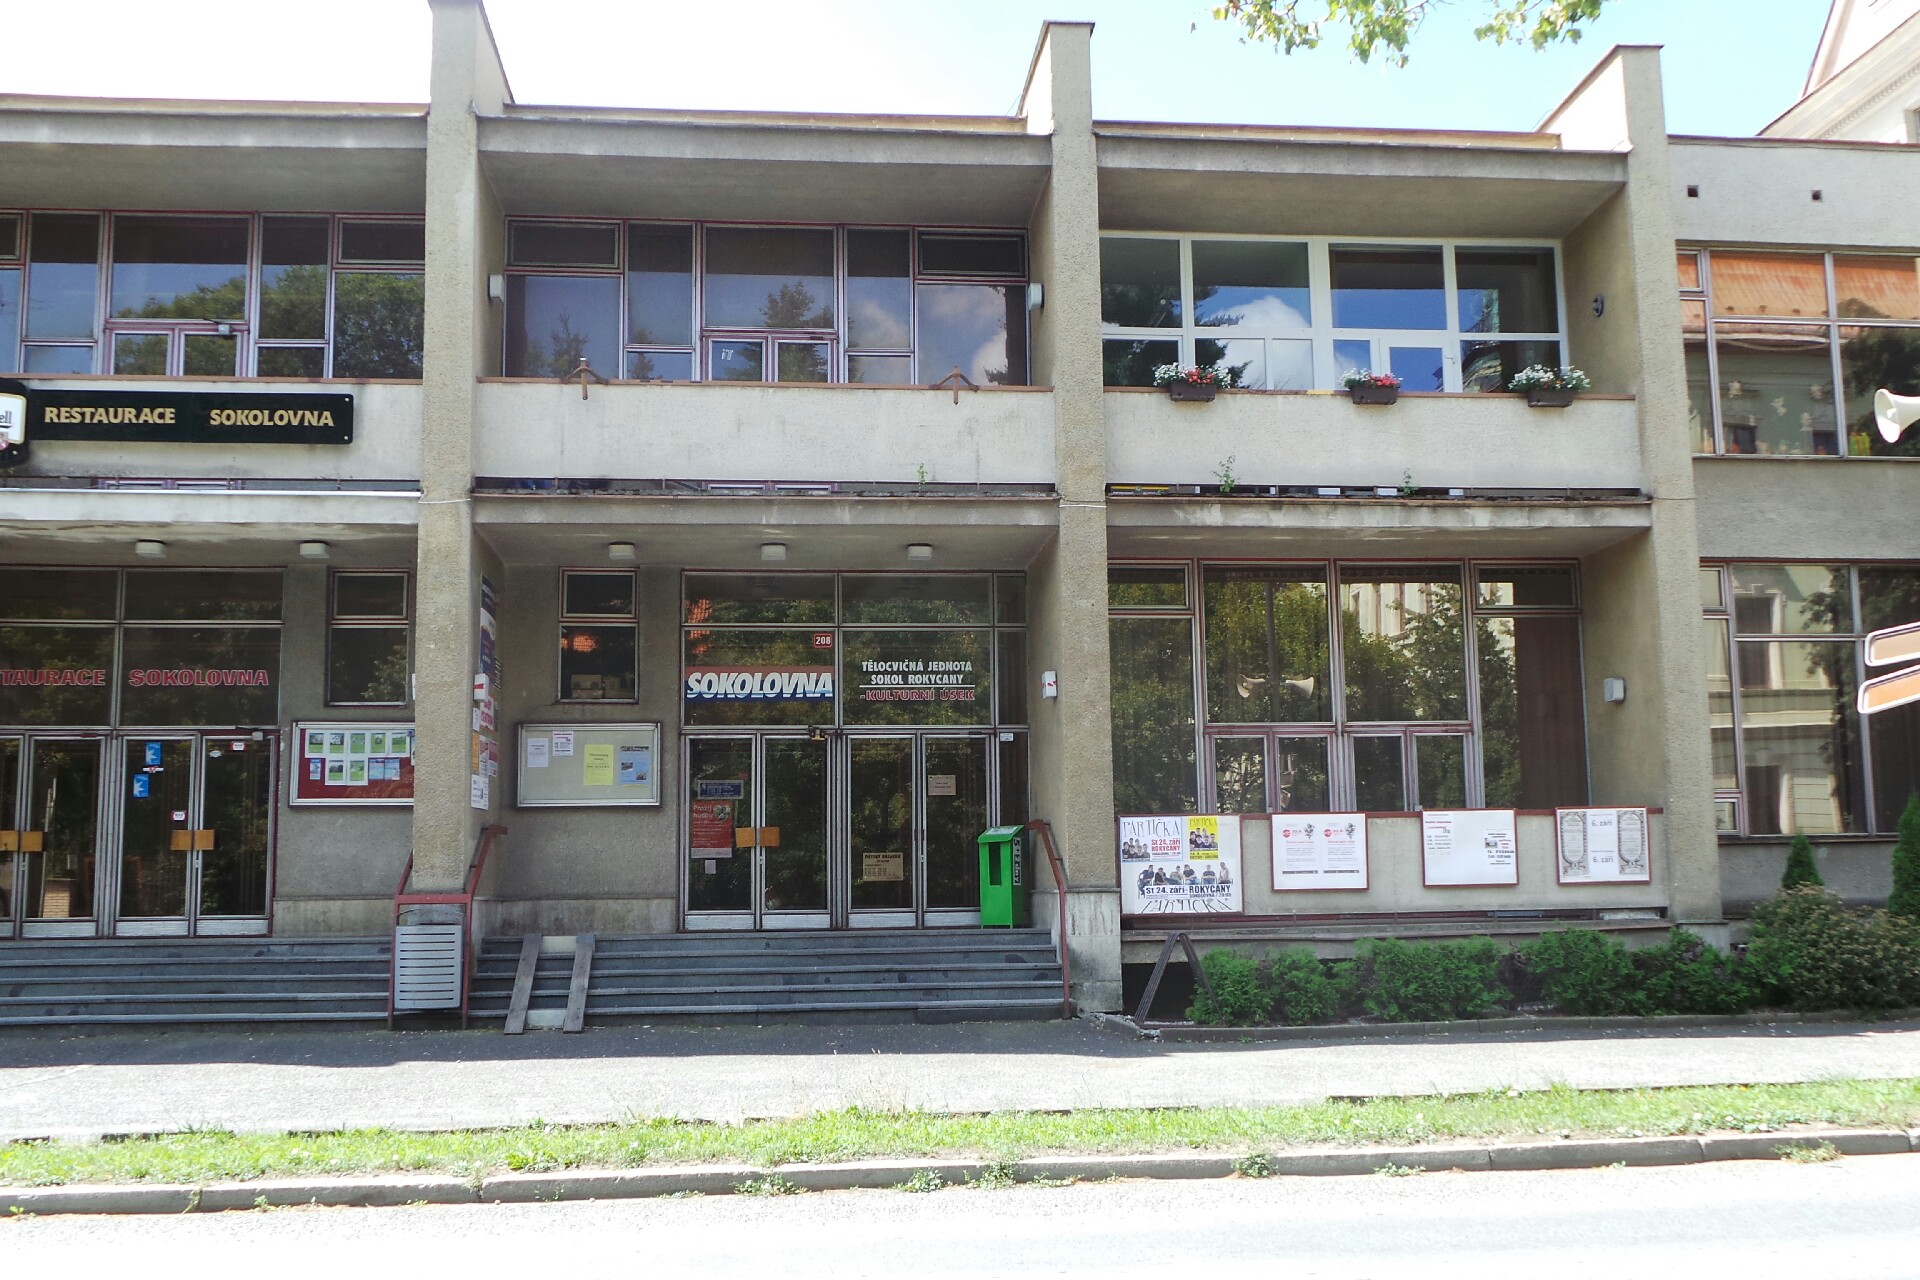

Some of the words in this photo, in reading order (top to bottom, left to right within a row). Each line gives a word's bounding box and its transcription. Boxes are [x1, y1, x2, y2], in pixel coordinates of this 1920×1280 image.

[44, 407, 176, 424] RESTAURACE
[209, 409, 335, 427] SOKOLOVNA
[815, 636, 831, 646] 208
[861, 658, 924, 672] TĚLOCVIČNÁ
[927, 661, 973, 672] JEDNOTA
[128, 669, 269, 686] SOKOLOVNA
[870, 674, 904, 685] SOKOL
[907, 674, 964, 685] ROKYCANY
[686, 672, 833, 698] SOKOLOVNA
[939, 687, 976, 701] ÚSEK
[1145, 886, 1154, 894] St
[1156, 886, 1168, 894] 24.
[1189, 884, 1231, 894] ROKYCANY
